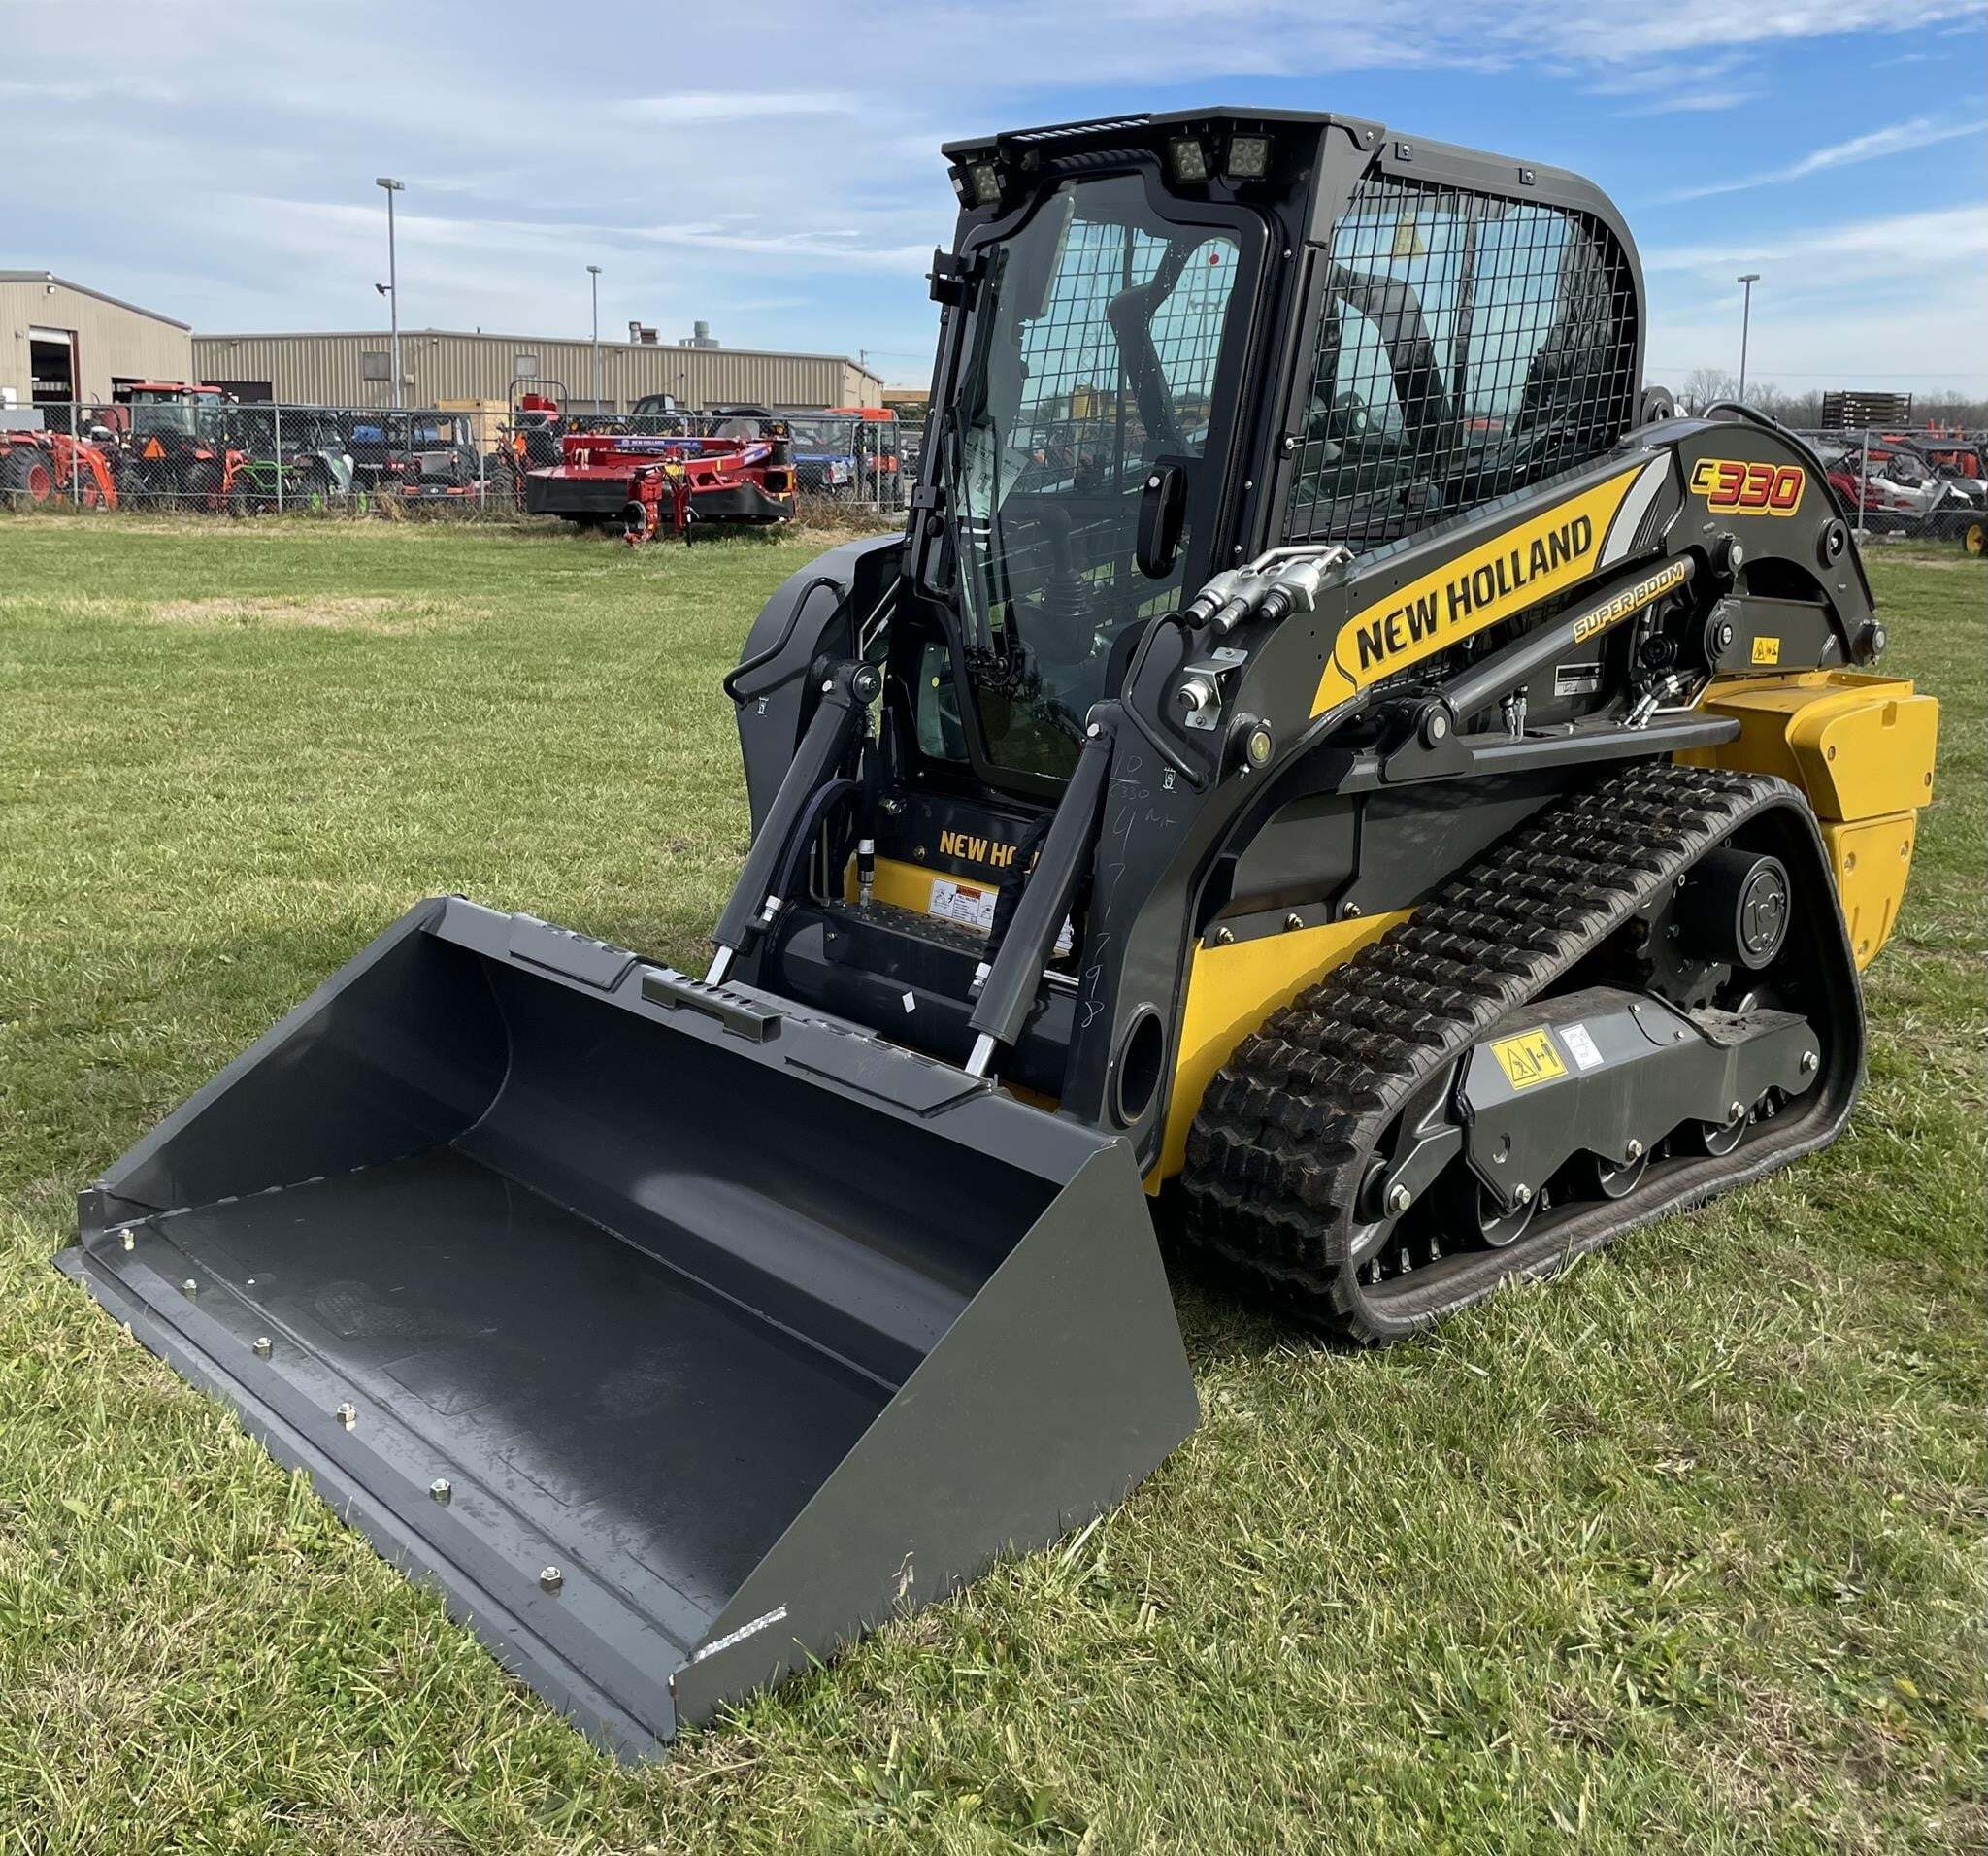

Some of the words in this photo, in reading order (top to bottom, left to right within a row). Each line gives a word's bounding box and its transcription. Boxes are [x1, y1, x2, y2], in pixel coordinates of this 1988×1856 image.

[1691, 460, 1804, 515] C330
[1355, 591, 1438, 671] NEW
[1446, 514, 1592, 623] HOLLAND
[1573, 591, 1634, 643] SUPER
[1634, 561, 1685, 607] BOOM
[939, 830, 988, 863] NEW
